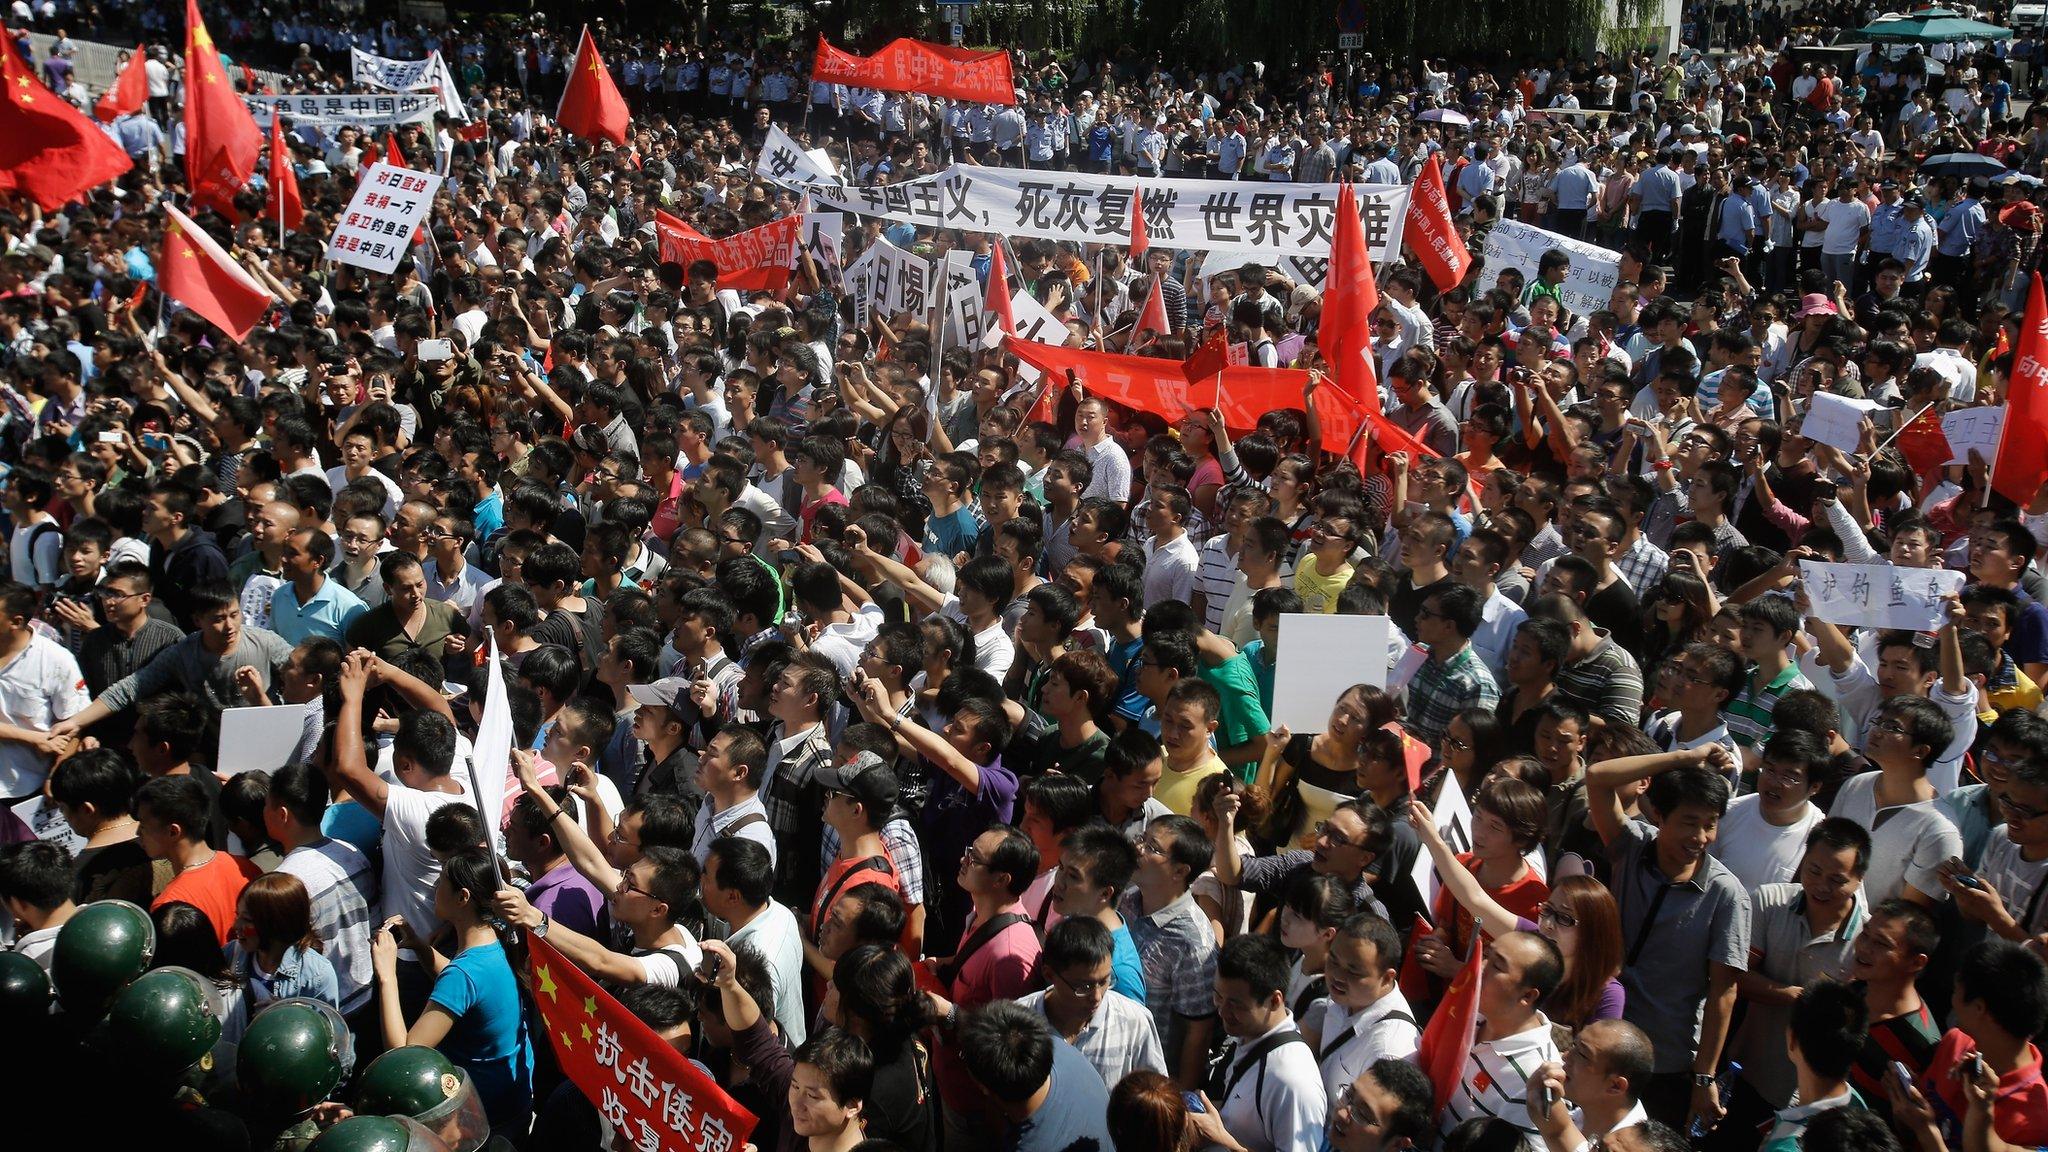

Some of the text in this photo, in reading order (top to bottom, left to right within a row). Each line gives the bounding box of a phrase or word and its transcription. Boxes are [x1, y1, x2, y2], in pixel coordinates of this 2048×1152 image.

[376, 171, 427, 193] 对日宣战
[364, 192, 416, 215] 我捐一万
[345, 212, 409, 239] 保卫钓鱼岛
[334, 234, 395, 261] 我是中国人
[602, 1086, 678, 1152] 收复
